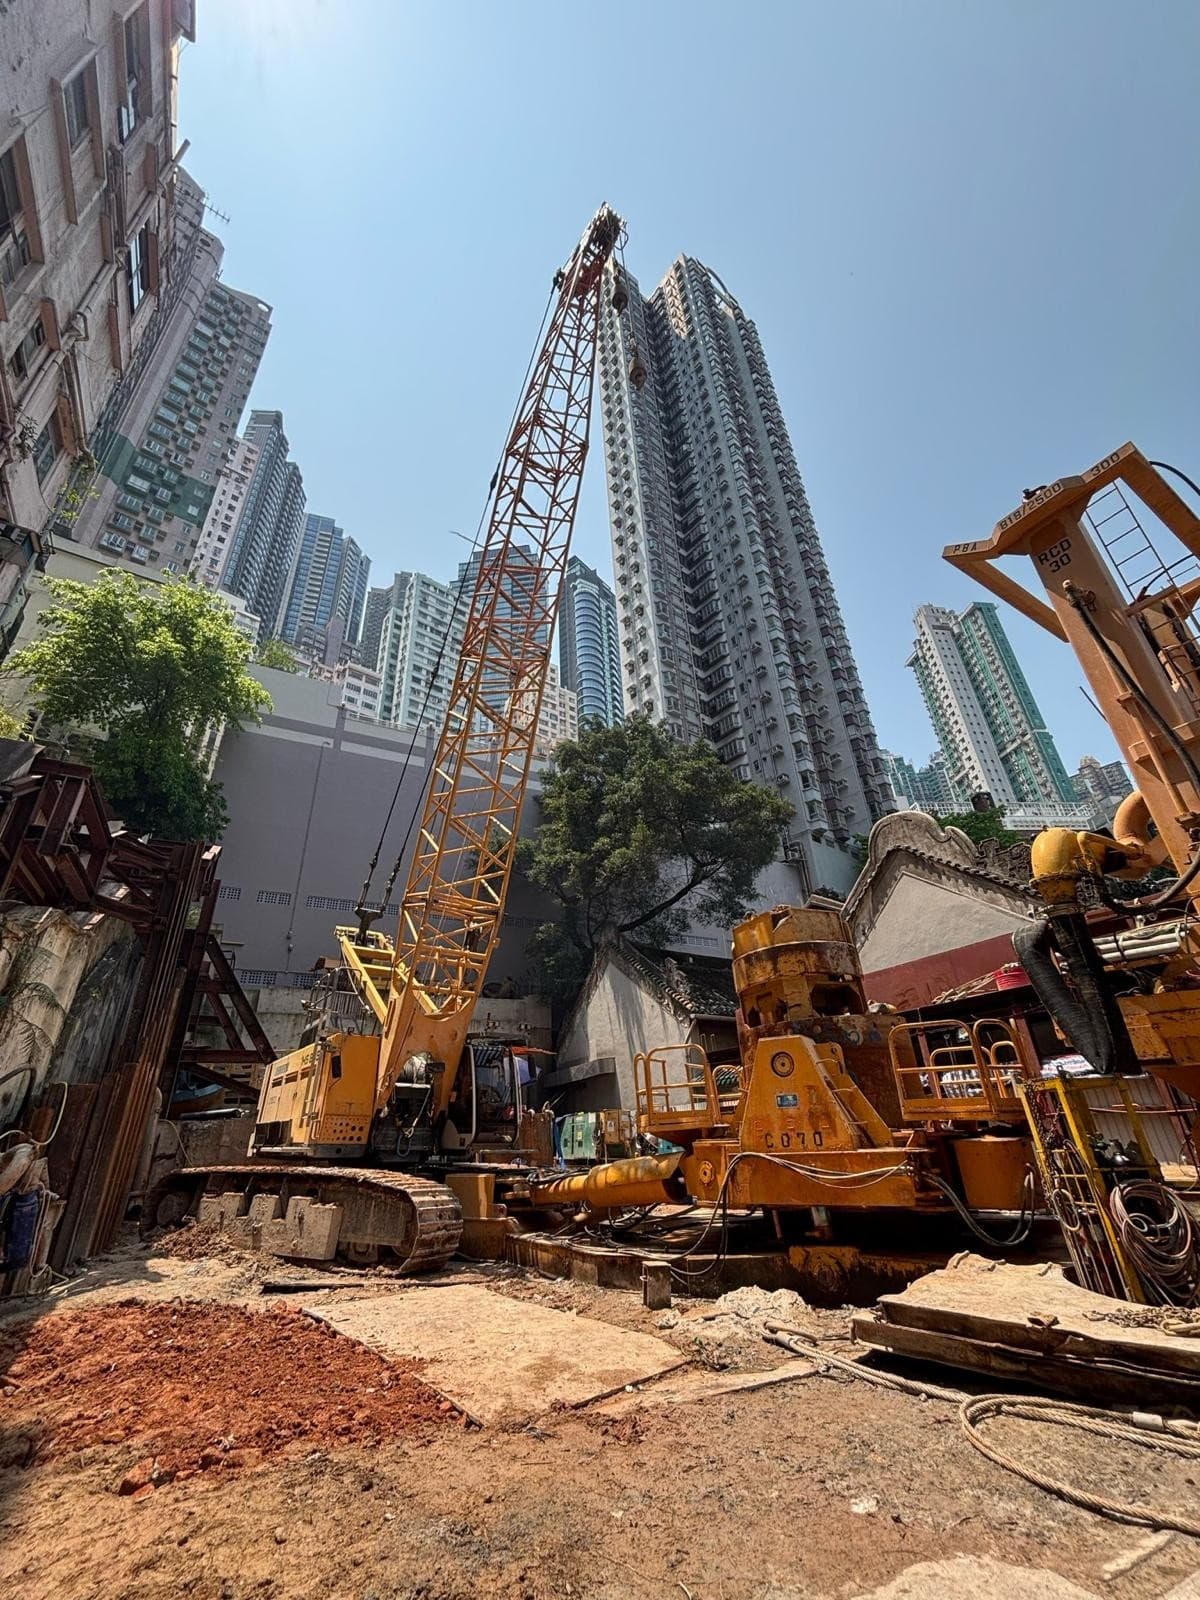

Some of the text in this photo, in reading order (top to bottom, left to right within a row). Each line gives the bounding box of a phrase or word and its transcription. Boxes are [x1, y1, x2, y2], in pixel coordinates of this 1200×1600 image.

[952, 452, 1121, 554] PBA 818/2500 300
[1038, 538, 1072, 566] RCD
[1049, 553, 1072, 573] 30
